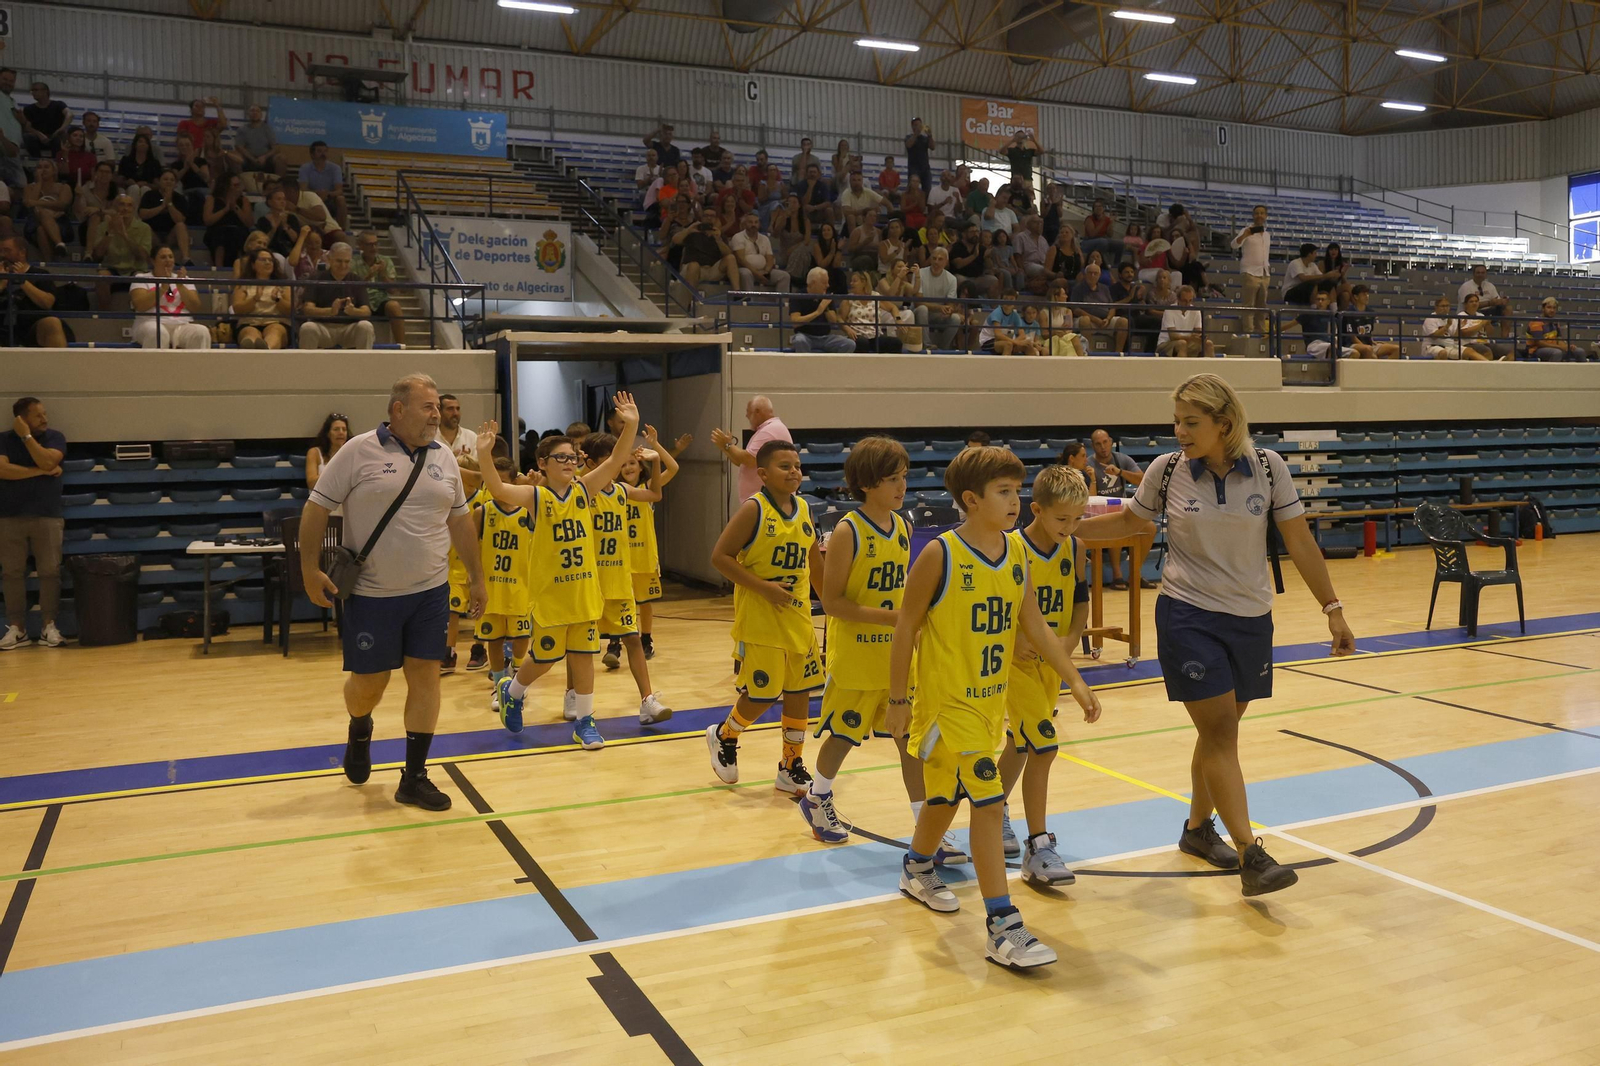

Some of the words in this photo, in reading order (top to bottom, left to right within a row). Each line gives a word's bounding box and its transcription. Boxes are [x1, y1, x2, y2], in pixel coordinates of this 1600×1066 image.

[747, 81, 758, 101] C
[987, 102, 1014, 119] Bar
[284, 125, 327, 137] Algeciras
[387, 124, 438, 136] Ayuntamiento
[397, 132, 438, 144] Algeciras
[1218, 126, 1227, 145] D
[458, 232, 528, 248] Delegación
[455, 250, 470, 261] de
[474, 250, 531, 264] Deportes
[503, 282, 514, 292] de
[517, 281, 565, 295] Algeciras
[553, 519, 587, 543] CBA
[594, 511, 623, 533] CBA
[492, 530, 519, 550] CBA
[599, 538, 617, 556] 18
[494, 555, 512, 573] 30
[560, 547, 583, 569] 35
[771, 541, 807, 570] CBA
[867, 561, 905, 592] CBA
[649, 586, 660, 595] 86
[1035, 585, 1064, 615] BA
[621, 615, 633, 626] 18
[971, 597, 1013, 635] CBA
[517, 620, 530, 631] 30
[804, 660, 819, 678] 22
[980, 644, 1004, 677] 16
